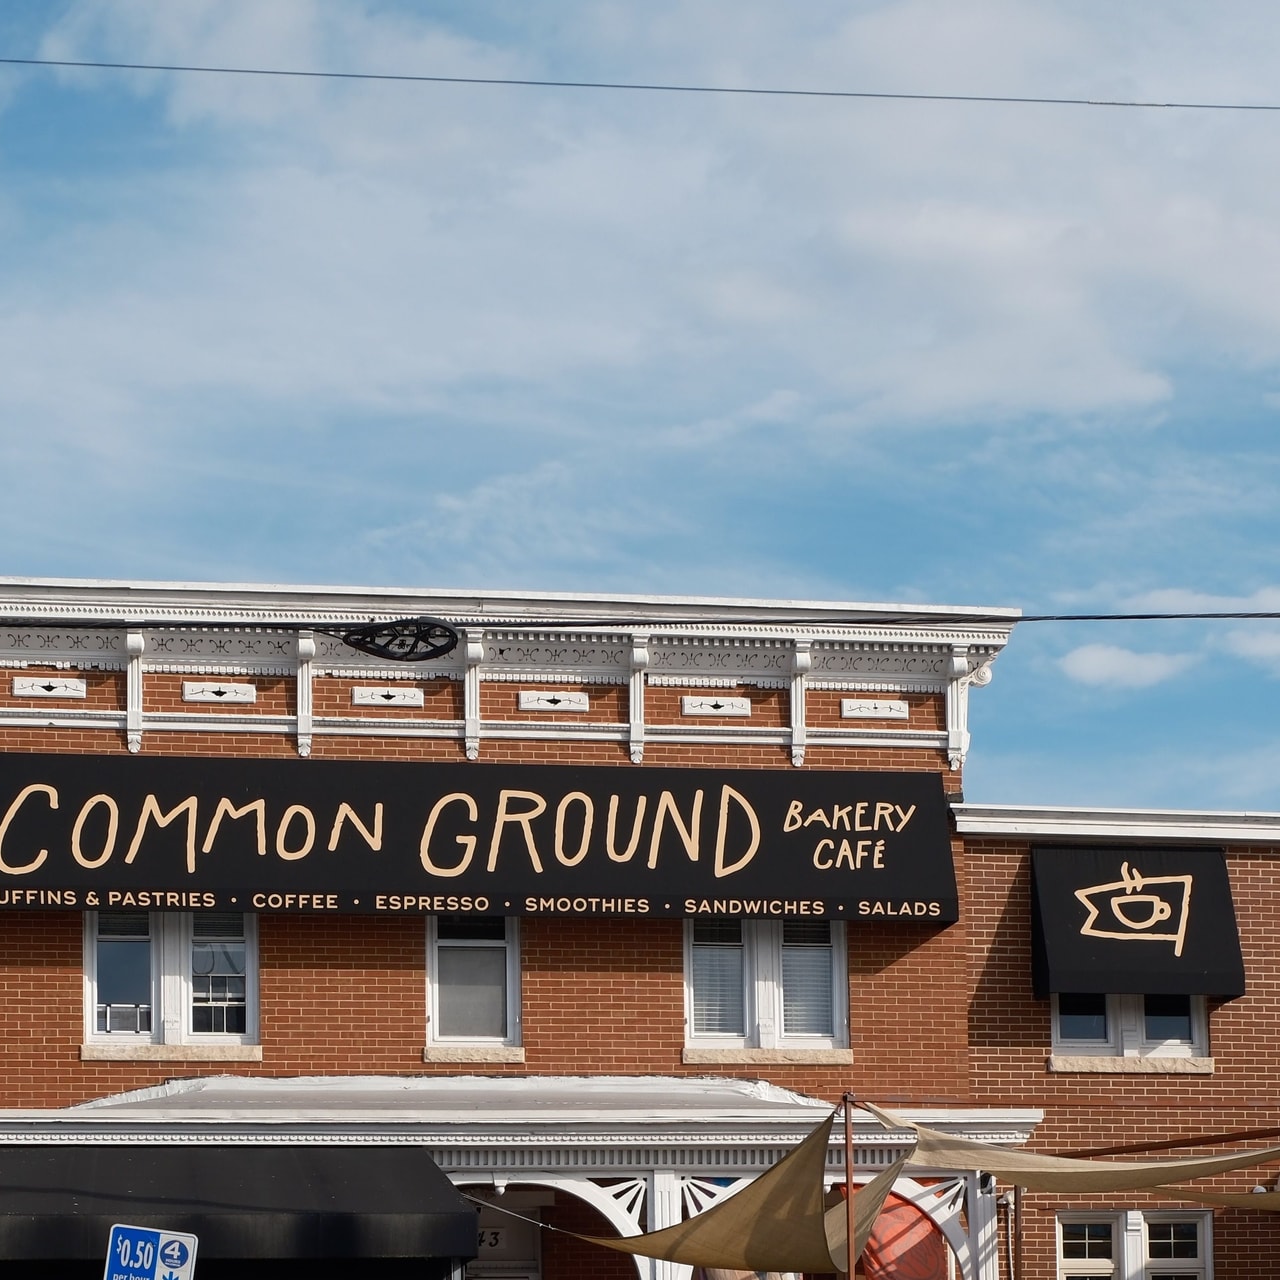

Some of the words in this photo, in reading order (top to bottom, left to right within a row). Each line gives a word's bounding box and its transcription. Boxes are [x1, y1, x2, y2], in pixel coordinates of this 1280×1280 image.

[420, 784, 760, 878] GROUND
[783, 800, 916, 833] BAKERY
[813, 839, 885, 870] CAFÉ
[85, 891, 101, 906] &
[109, 891, 216, 908] PASTRIES
[252, 894, 339, 910] COFFEE
[375, 895, 489, 912] ESPRESSO
[524, 897, 650, 913] SMOOTHIES
[684, 899, 825, 916] SANDWICHES
[858, 901, 941, 917] SALADS
[116, 1234, 154, 1270] $0.50
[164, 1241, 181, 1259] 4
